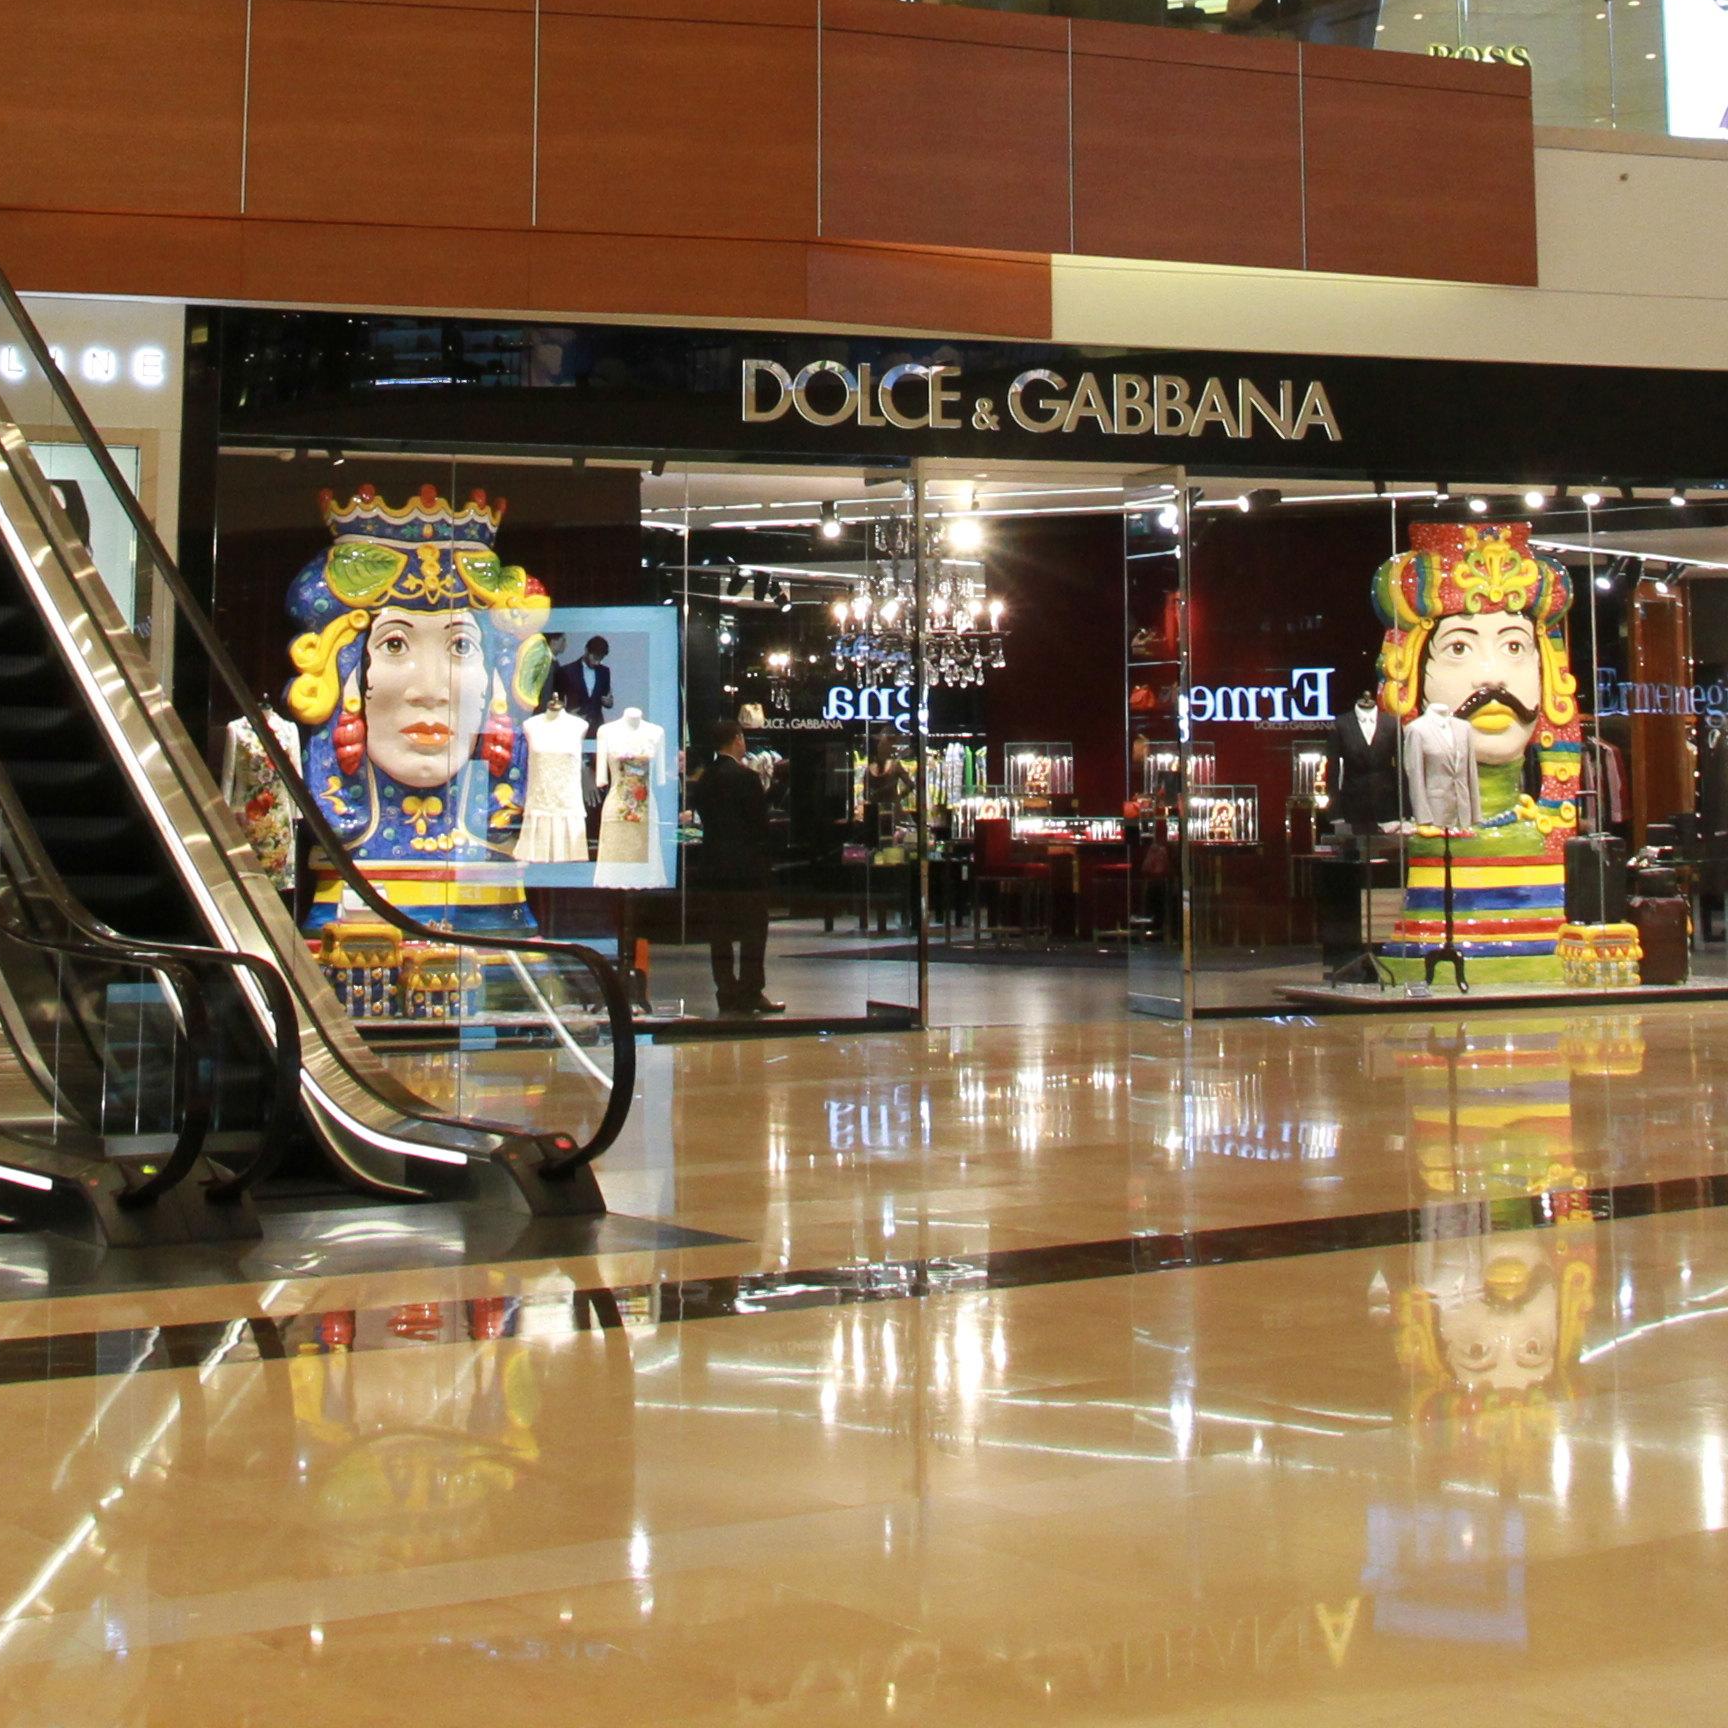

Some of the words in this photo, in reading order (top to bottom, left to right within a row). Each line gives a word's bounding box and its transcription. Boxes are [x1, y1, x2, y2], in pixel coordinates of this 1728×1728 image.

[742, 358, 962, 430] DOLCE
[971, 397, 1000, 432] &
[1007, 368, 1343, 442] GABBANA
